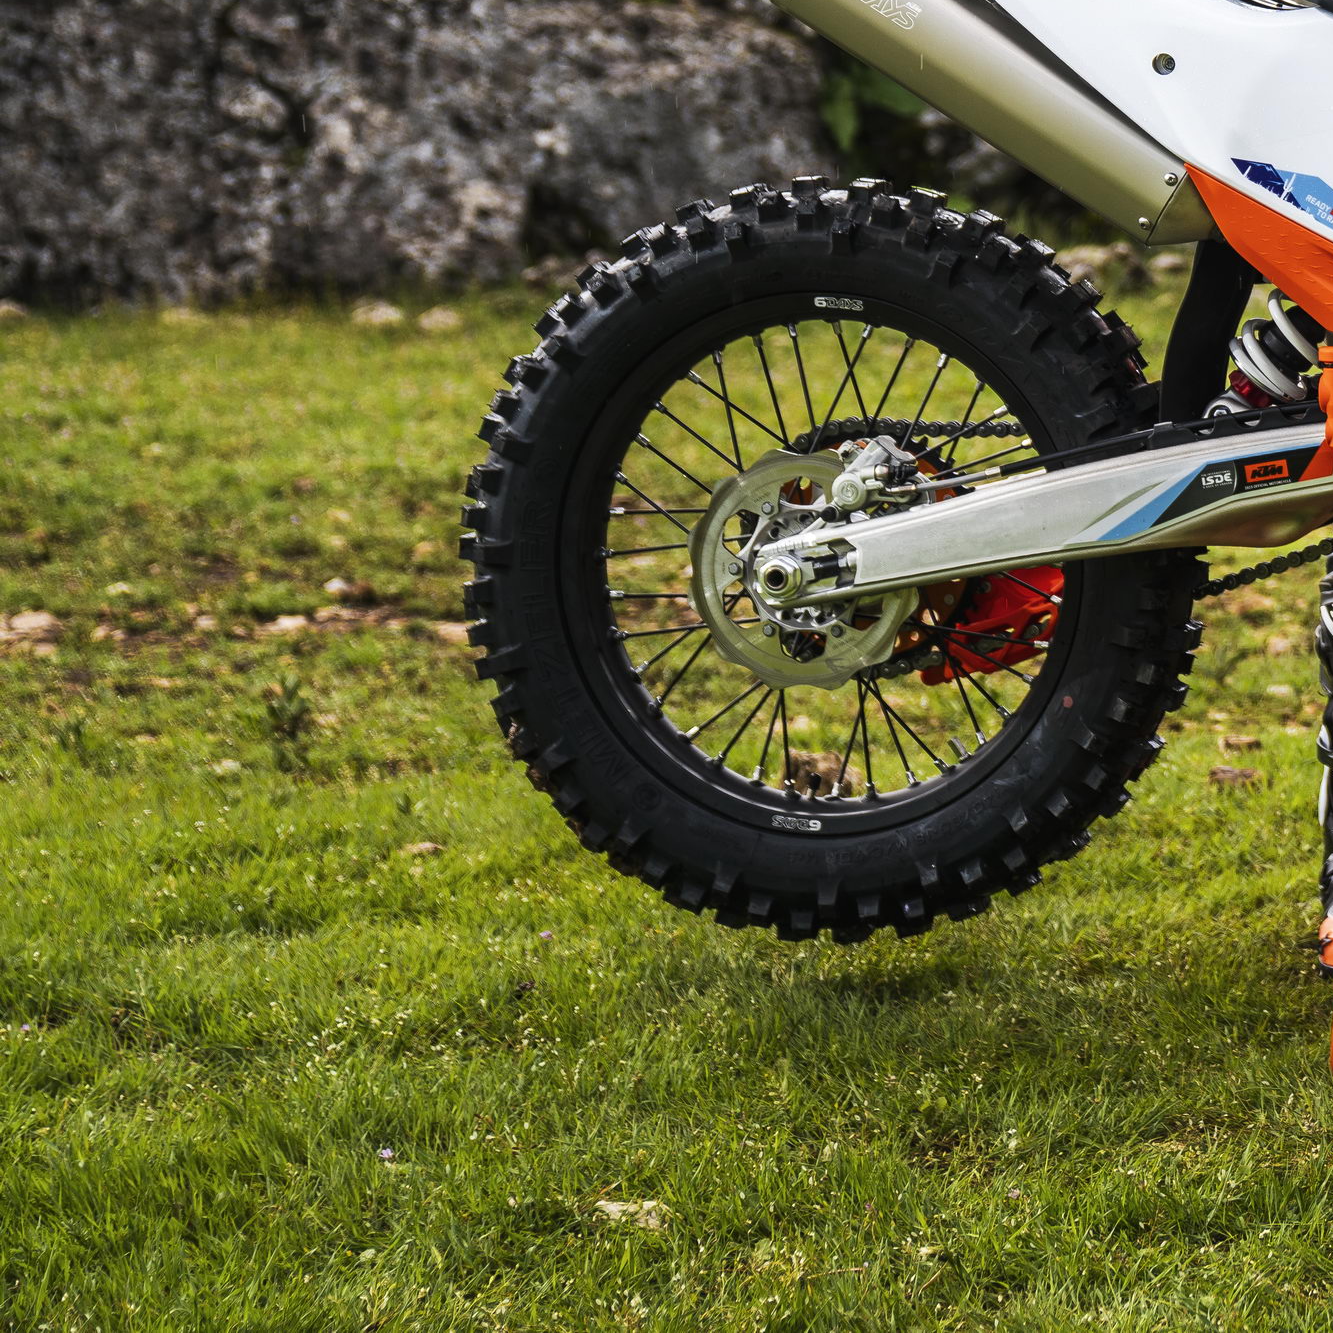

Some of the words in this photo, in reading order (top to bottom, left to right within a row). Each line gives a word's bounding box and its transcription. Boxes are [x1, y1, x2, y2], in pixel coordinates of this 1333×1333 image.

[1305, 194, 1331, 213] READY
[1316, 209, 1326, 219] TO
[1251, 464, 1284, 479] KTM
[1201, 472, 1232, 486] ISDE
